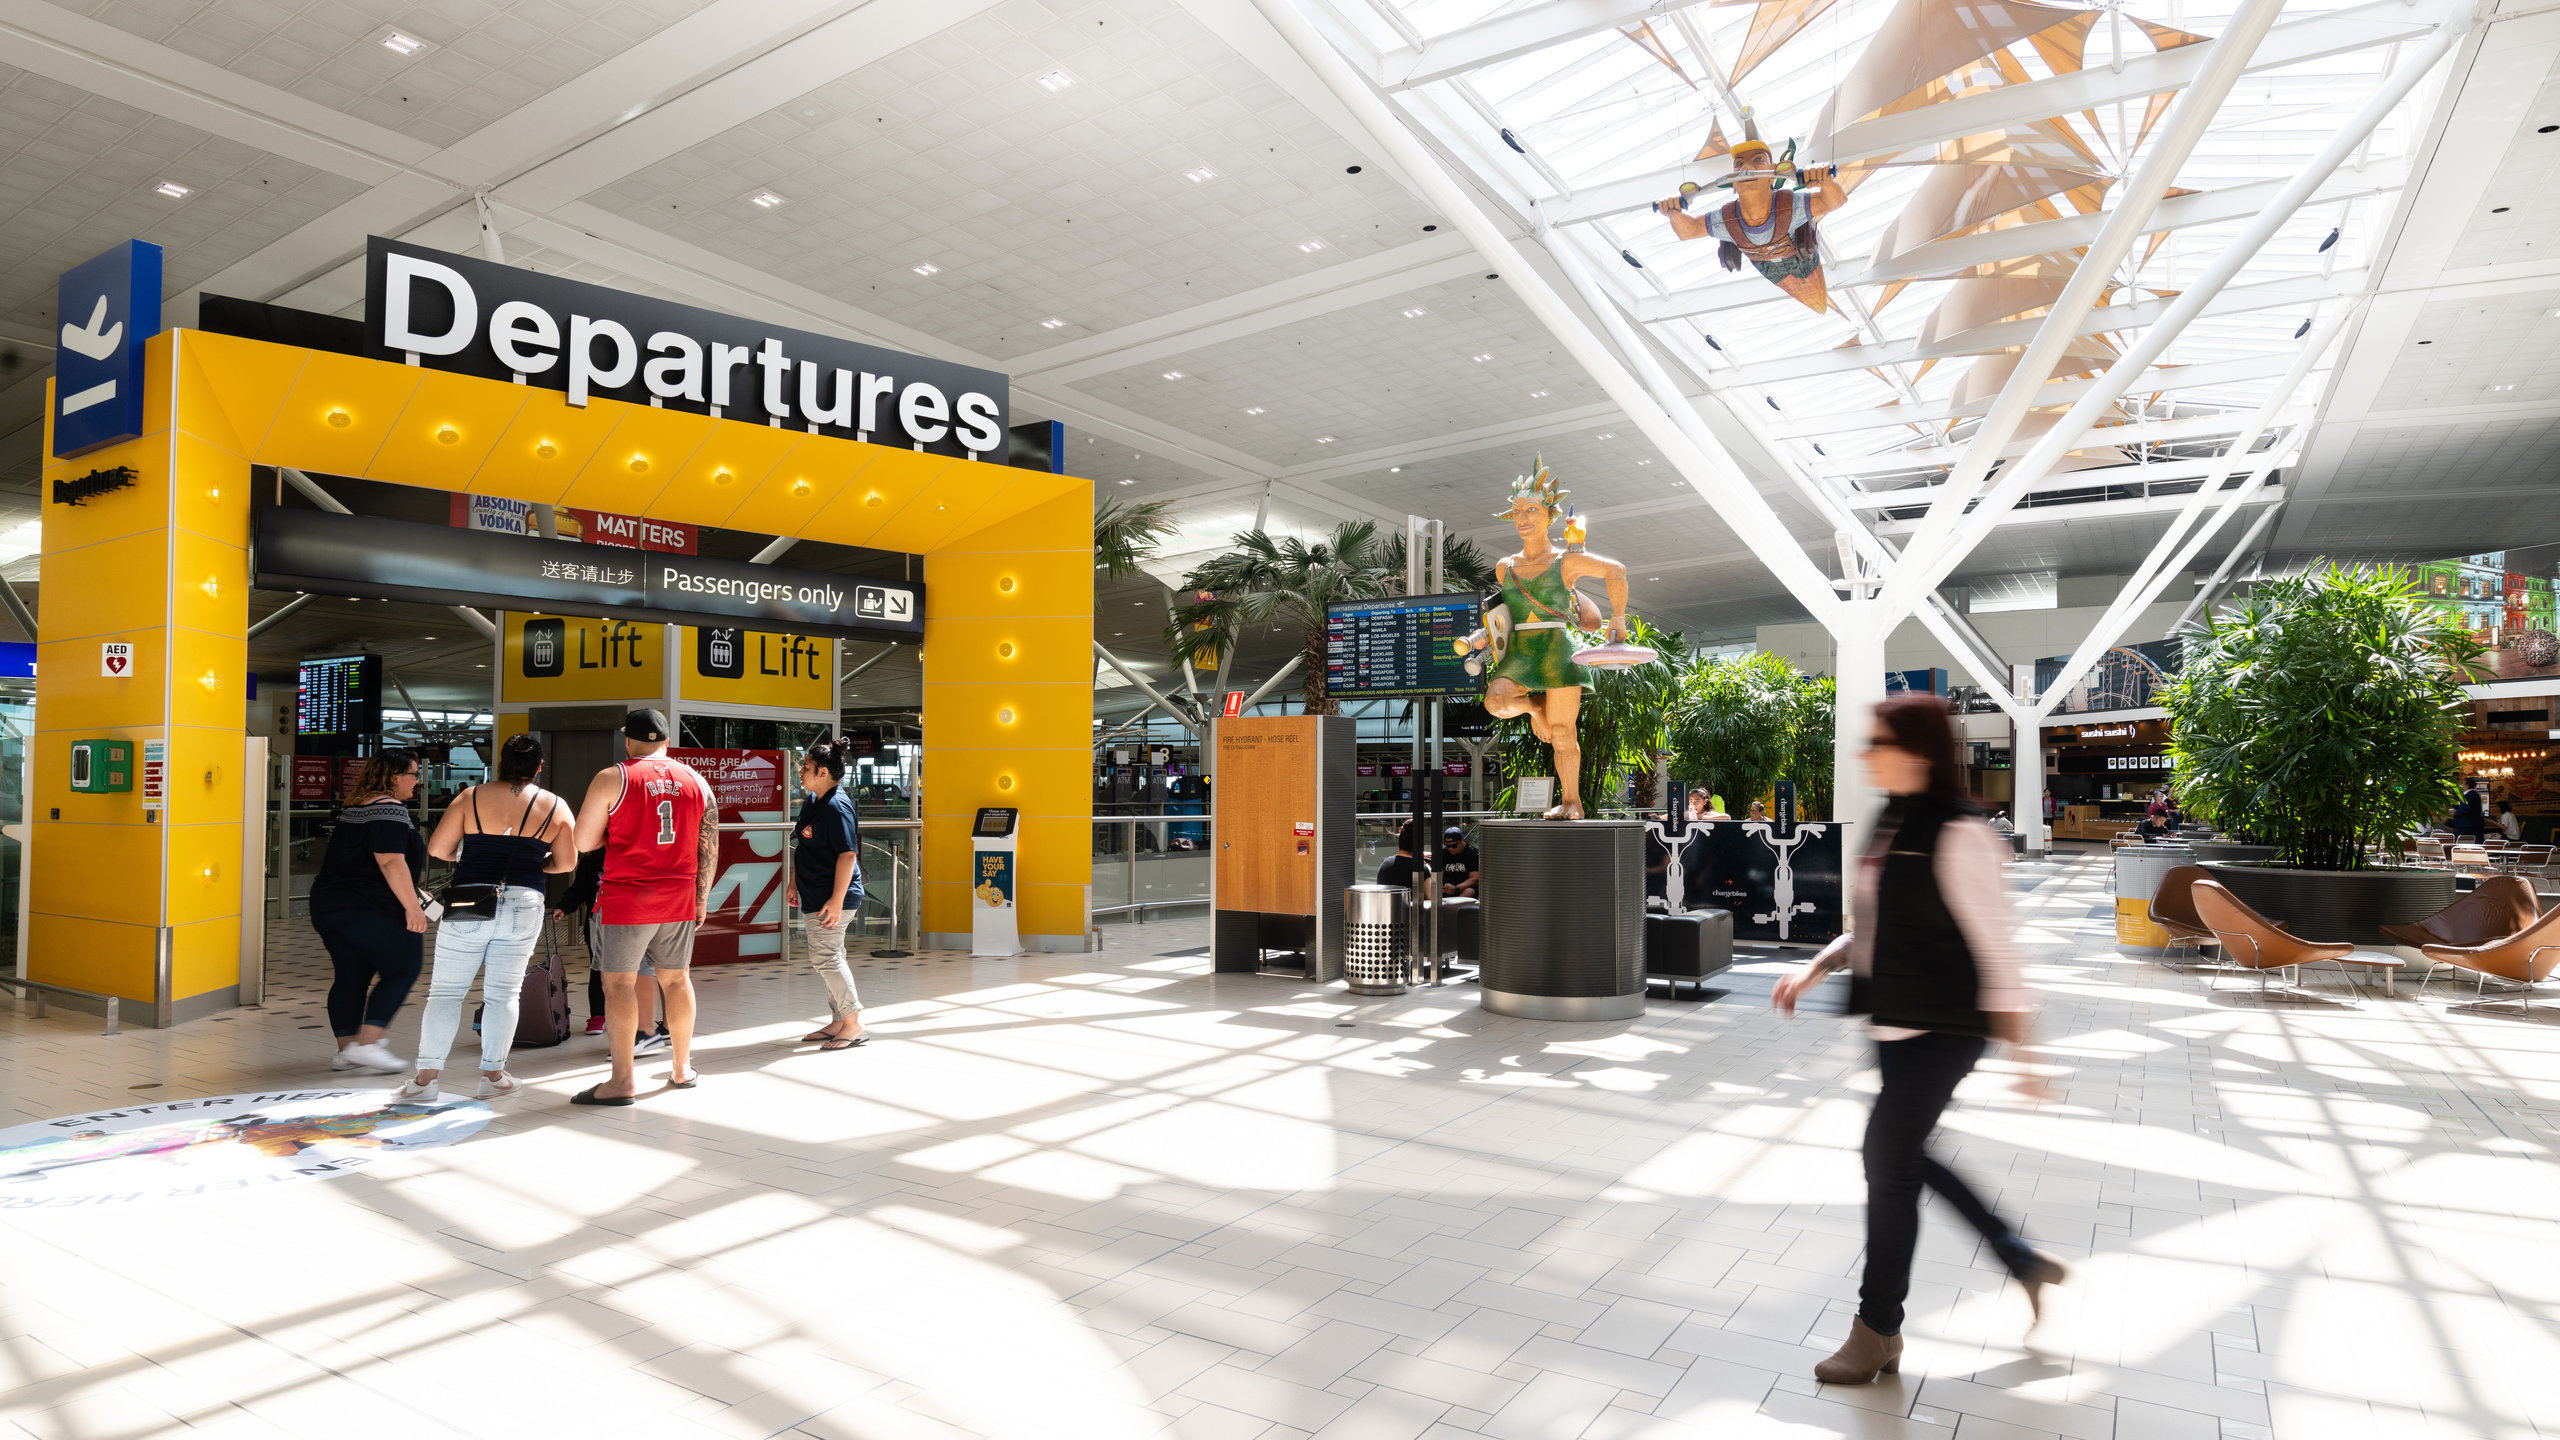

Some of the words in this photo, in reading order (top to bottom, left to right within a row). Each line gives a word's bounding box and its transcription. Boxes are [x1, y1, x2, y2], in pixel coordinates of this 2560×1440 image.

[385, 252, 1001, 408] Departures
[53, 466, 128, 506] Departures
[475, 495, 526, 516] ABSOLUT
[479, 513, 522, 534] VODKA
[597, 514, 684, 548] MATTERS
[541, 560, 635, 585] 送客请止步
[663, 567, 793, 604] Passengers
[798, 583, 844, 612] only
[1328, 604, 1363, 612] International
[1364, 602, 1395, 610] Departures
[106, 645, 127, 654] AED
[579, 621, 643, 669] Lift
[760, 635, 820, 680] Lift
[1223, 736, 1235, 744] FIRE
[1236, 735, 1262, 743] HYDRANT
[1268, 734, 1284, 743] HOSE
[1285, 733, 1299, 742] REEL
[2081, 729, 2103, 738] sushi
[2104, 728, 2128, 737] sushi
[719, 758, 748, 767] AREA
[1489, 763, 1497, 774] 2
[730, 770, 758, 779] AREA
[1117, 776, 1131, 785] ATM
[1152, 776, 1166, 785] ATM
[646, 779, 682, 796] ROSE
[743, 783, 764, 793] only
[726, 796, 743, 804] this
[745, 796, 769, 805] point
[657, 800, 676, 844] 1
[1672, 797, 1680, 833] chargebikes
[1780, 798, 1788, 834] chargebikes
[982, 856, 1004, 864] HAVE
[982, 863, 1005, 871] YOUR
[1712, 889, 1747, 898] chargebikes
[49, 1098, 235, 1129] ENTER
